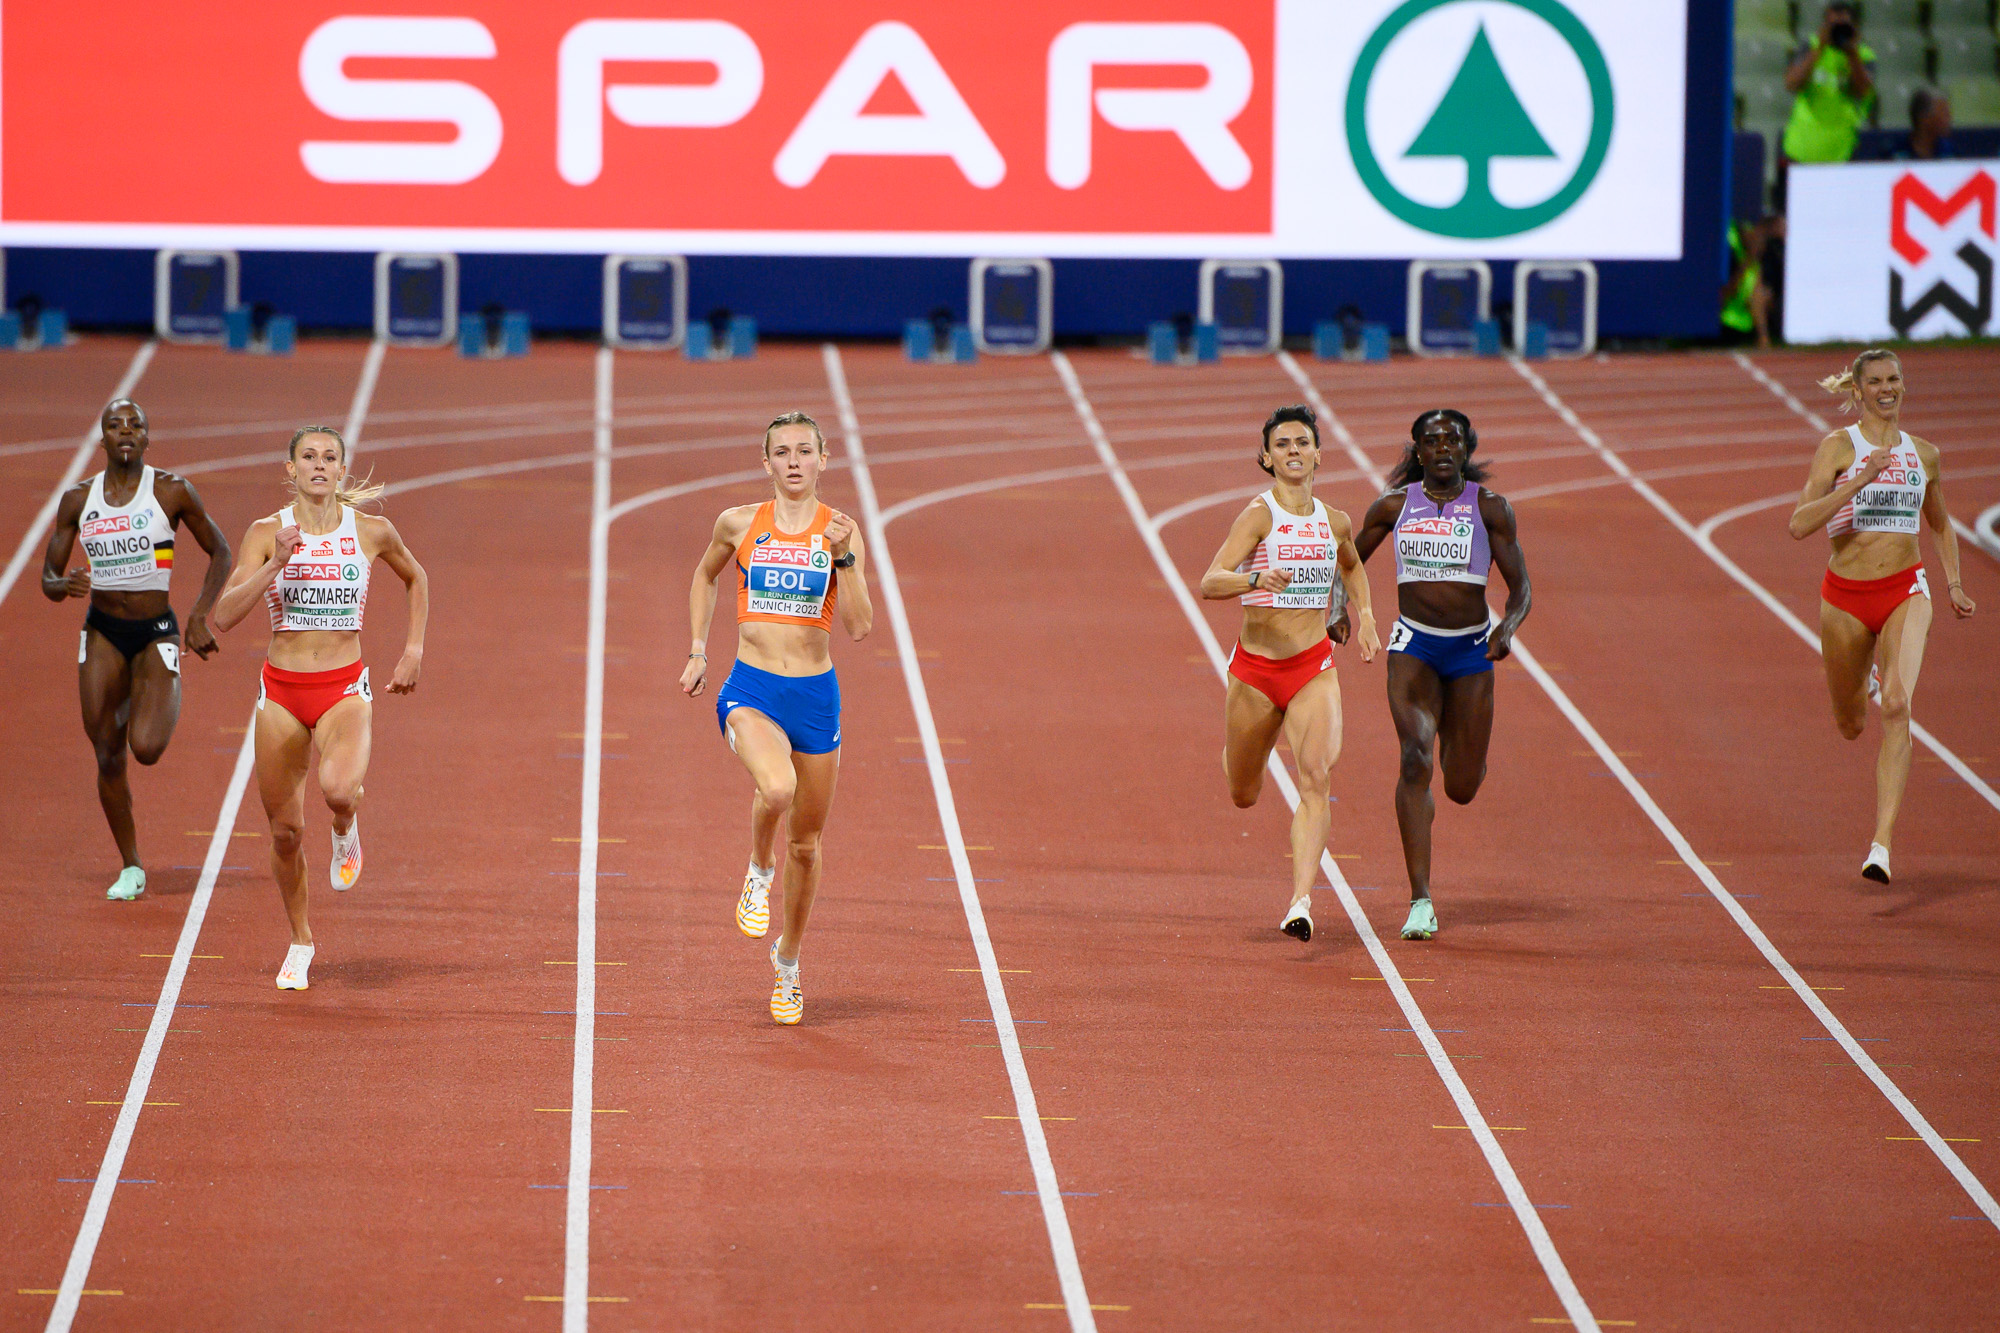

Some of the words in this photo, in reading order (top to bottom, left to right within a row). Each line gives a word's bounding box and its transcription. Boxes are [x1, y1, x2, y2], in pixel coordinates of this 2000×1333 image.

[299, 15, 1253, 189] SPAR
[1856, 491, 1921, 508] BAUMGART-WITAN
[83, 517, 129, 536] SPAR
[1277, 525, 1293, 534] 4F
[1401, 521, 1451, 534] SPAR
[1857, 518, 1896, 527] MUNICH
[1899, 519, 1916, 528] 2022
[85, 536, 150, 557] BOLINGO
[1280, 546, 1325, 558] SPAR
[1399, 540, 1468, 560] OHURUOGU
[754, 549, 809, 564] SPAR
[94, 566, 126, 578] MUNICH
[130, 562, 152, 575] 2022
[284, 565, 340, 579] SPAR
[1405, 566, 1437, 579] MUNICH
[764, 569, 812, 592] BOL
[283, 587, 360, 605] KACZMAREK
[768, 592, 782, 600] RUN
[1278, 596, 1315, 605] MUNICH
[752, 599, 792, 612] MUNICH
[795, 604, 818, 615] 2022
[287, 614, 328, 627] MUNICH
[331, 617, 355, 627] 2022
